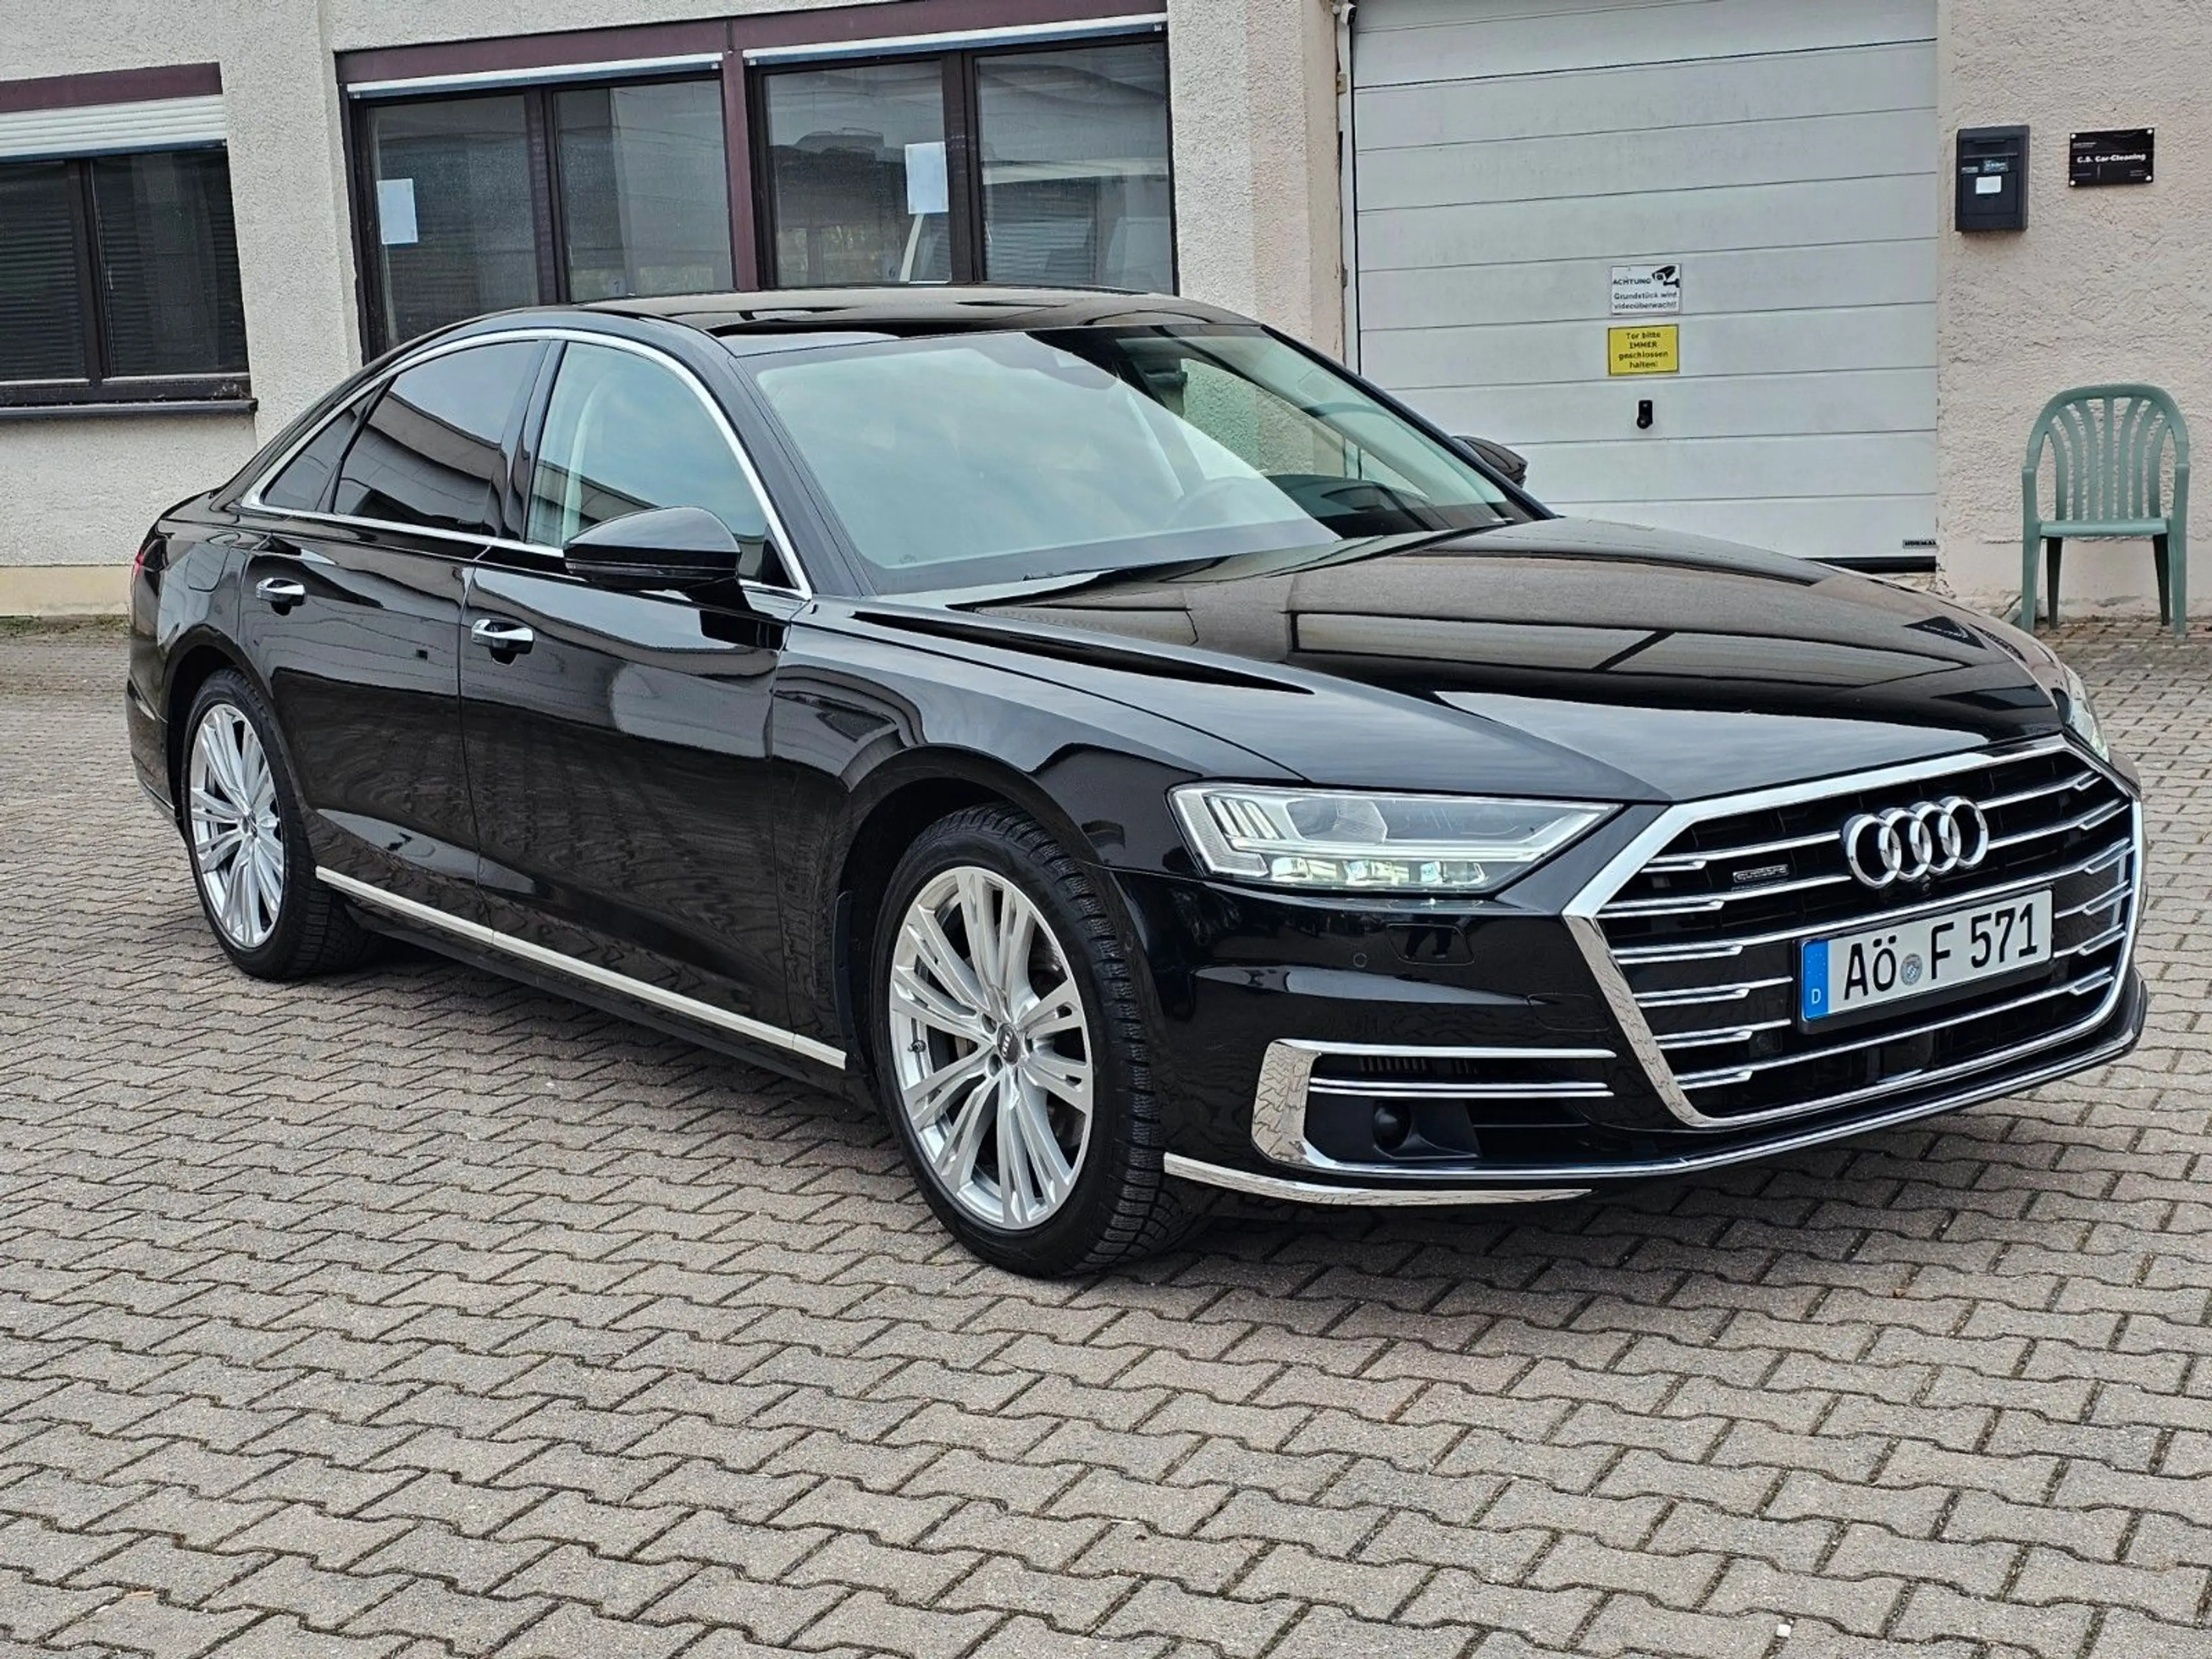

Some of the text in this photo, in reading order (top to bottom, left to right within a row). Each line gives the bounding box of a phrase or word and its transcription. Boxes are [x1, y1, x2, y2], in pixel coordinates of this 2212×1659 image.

[1614, 291, 1658, 300] Grundstück
[1642, 331, 1661, 339] bitte
[1629, 340, 1658, 349] IMMER
[1619, 351, 1668, 361] geschlossen
[1844, 934, 1897, 1000] AÖ
[1931, 922, 1955, 980] F
[1971, 902, 2037, 969] 571
[1811, 987, 1821, 1005] D
